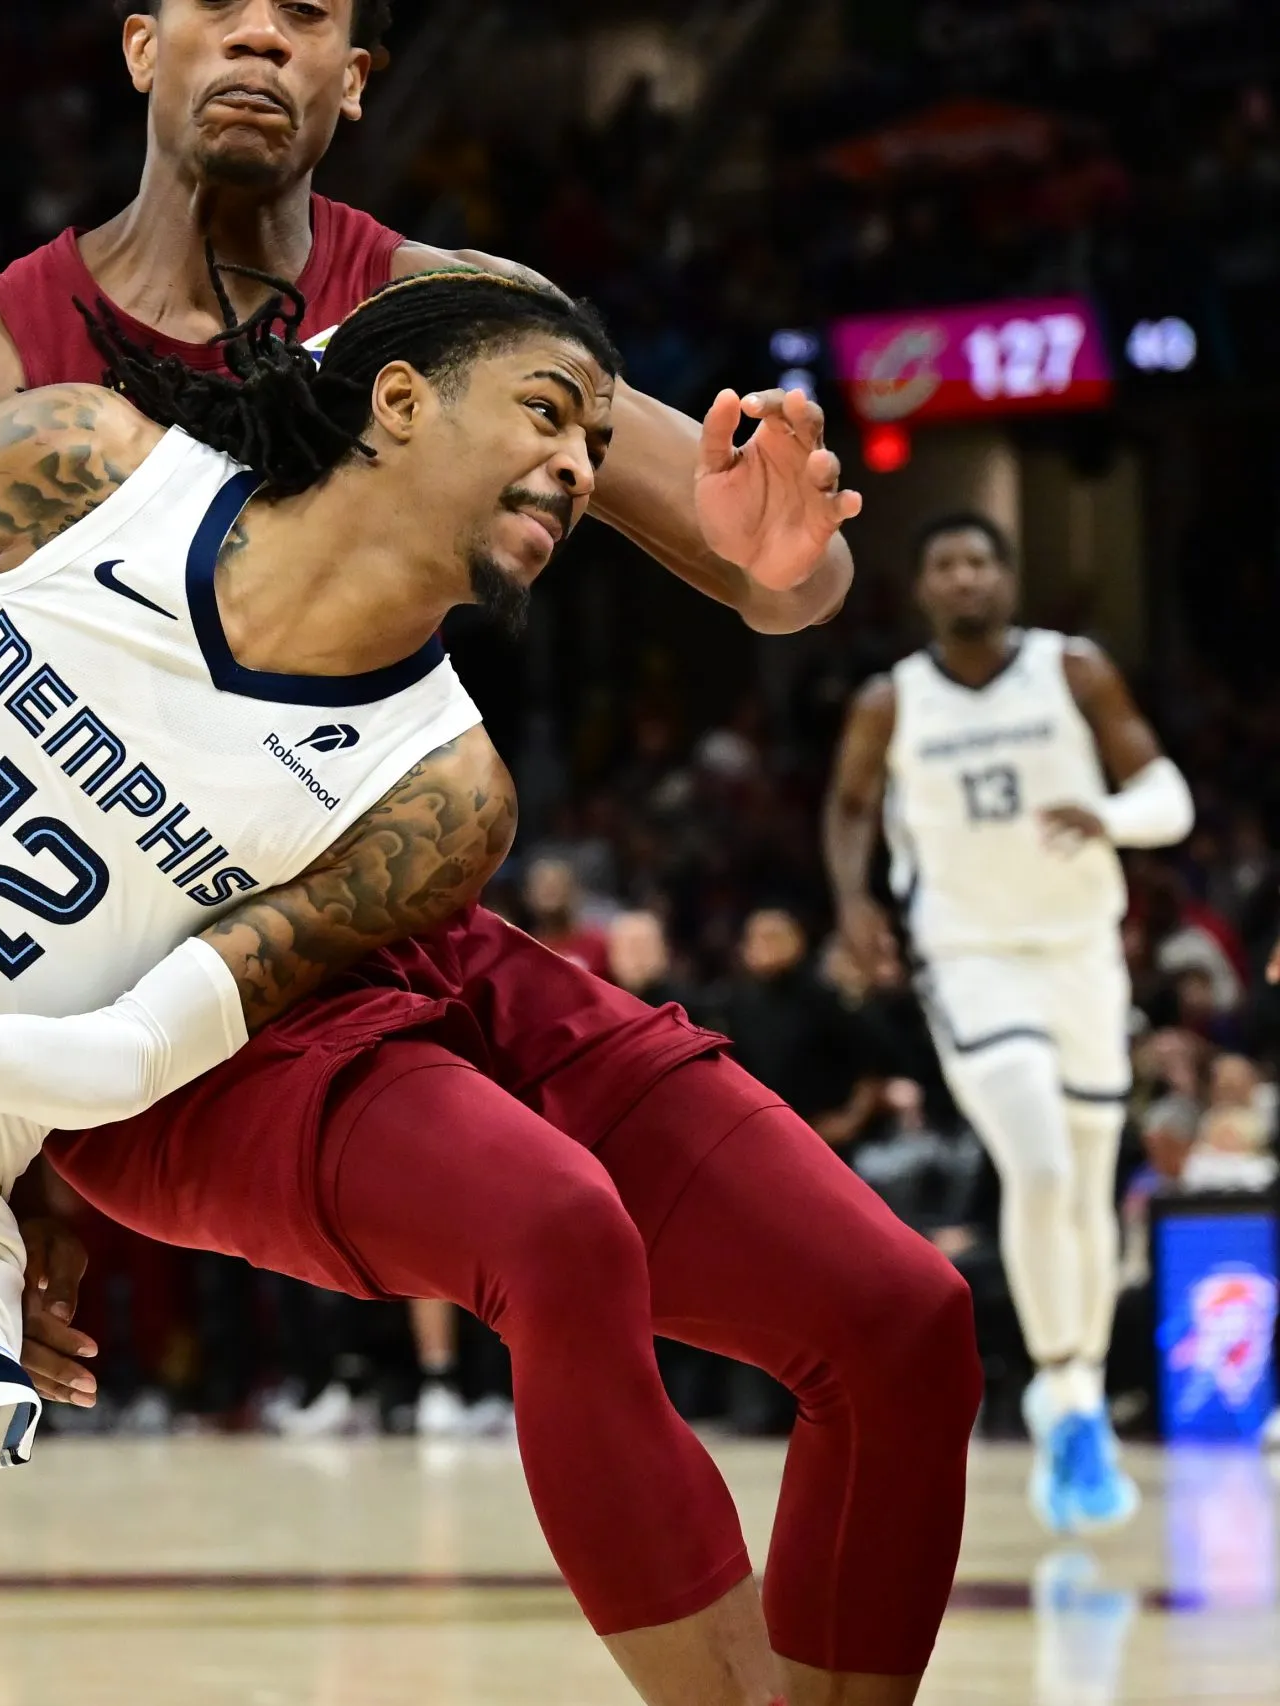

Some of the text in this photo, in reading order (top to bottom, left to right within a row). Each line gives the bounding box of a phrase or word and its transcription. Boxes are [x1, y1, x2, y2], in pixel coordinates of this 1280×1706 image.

[962, 313, 1086, 399] 127
[262, 732, 341, 811] Robinhood
[960, 763, 1022, 823] 13
